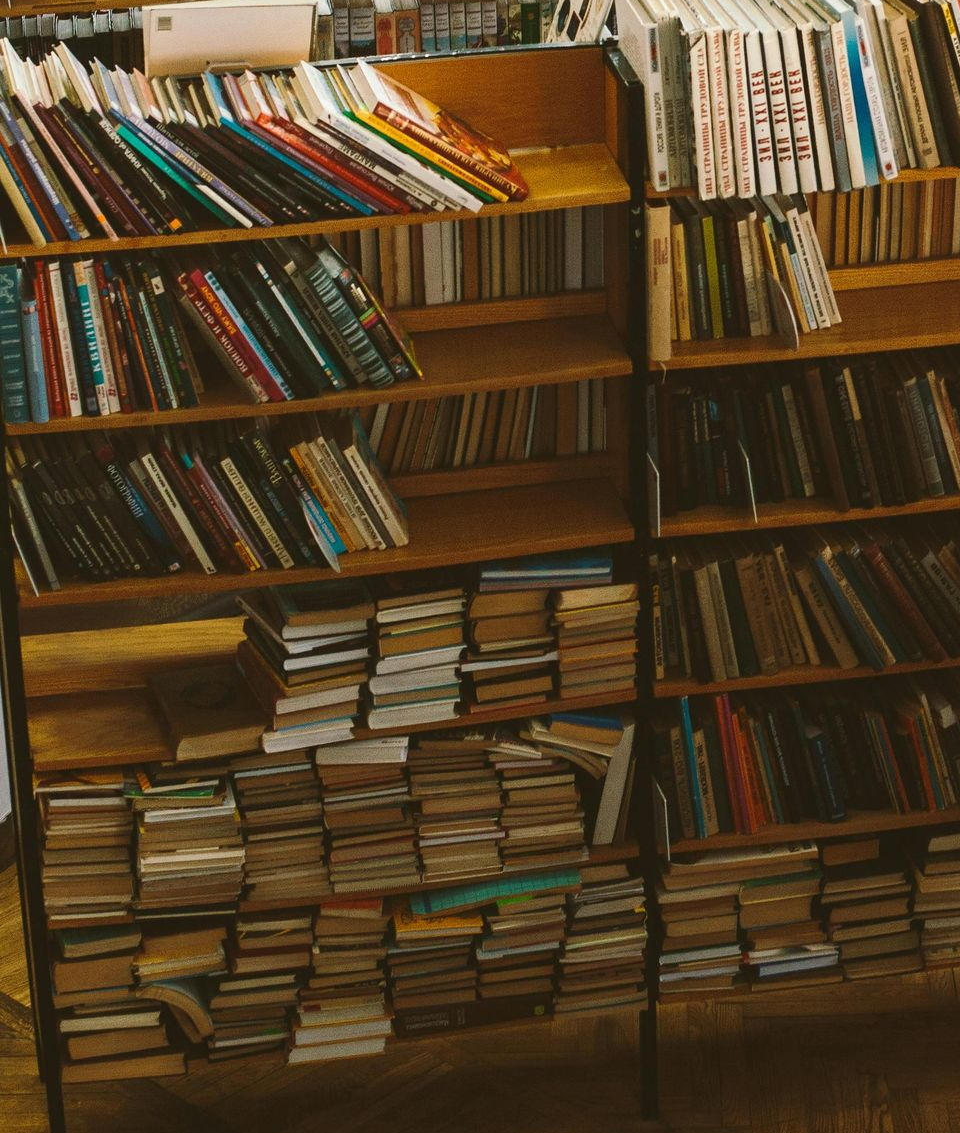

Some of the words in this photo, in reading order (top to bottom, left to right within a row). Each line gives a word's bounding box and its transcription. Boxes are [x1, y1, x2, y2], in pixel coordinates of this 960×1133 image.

[732, 31, 741, 65] СЛАВЫ
[697, 67, 708, 118] ТРУДОВОЙ
[714, 66, 725, 115] ТРУДОВОЙ
[735, 68, 745, 117] ТРУДОВОЙ
[121, 145, 141, 169] КНИГА
[337, 140, 377, 171] МАКРАМЕ
[701, 122, 712, 173] СТРАНИЦЫ
[718, 119, 729, 171] СТРАНИЦЫ
[738, 120, 749, 173] СТРАНИЦЫ
[757, 136, 771, 162] ЗИЛ
[778, 136, 792, 162] ЗИЛ
[795, 135, 810, 161] ЗИЛ
[704, 175, 713, 195] ЗИЛ
[742, 176, 750, 193] ЗИЛ
[193, 296, 216, 326] ФЕТР
[80, 299, 101, 373] КВИЛИНГ
[218, 331, 249, 375] ВОЙЛОК
